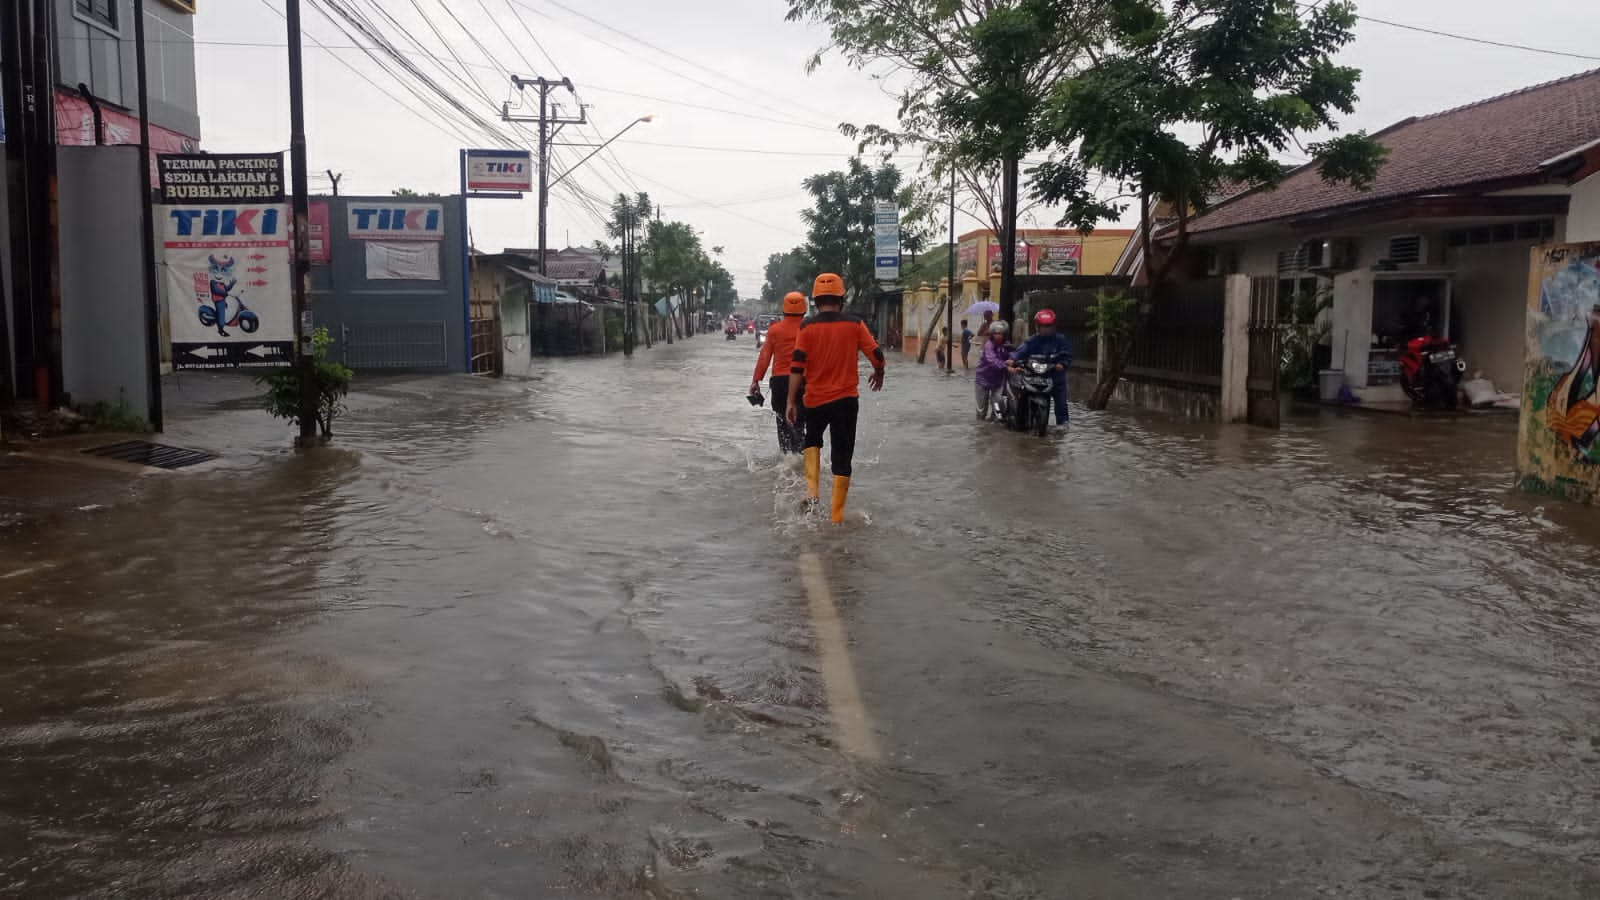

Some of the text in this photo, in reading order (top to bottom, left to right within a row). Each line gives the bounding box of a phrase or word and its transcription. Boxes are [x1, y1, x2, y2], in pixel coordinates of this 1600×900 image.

[163, 158, 279, 170] TERIMA PACKING
[163, 171, 278, 183] SEDIA LAKBAN &
[165, 184, 280, 198] BUBBLEWRAP
